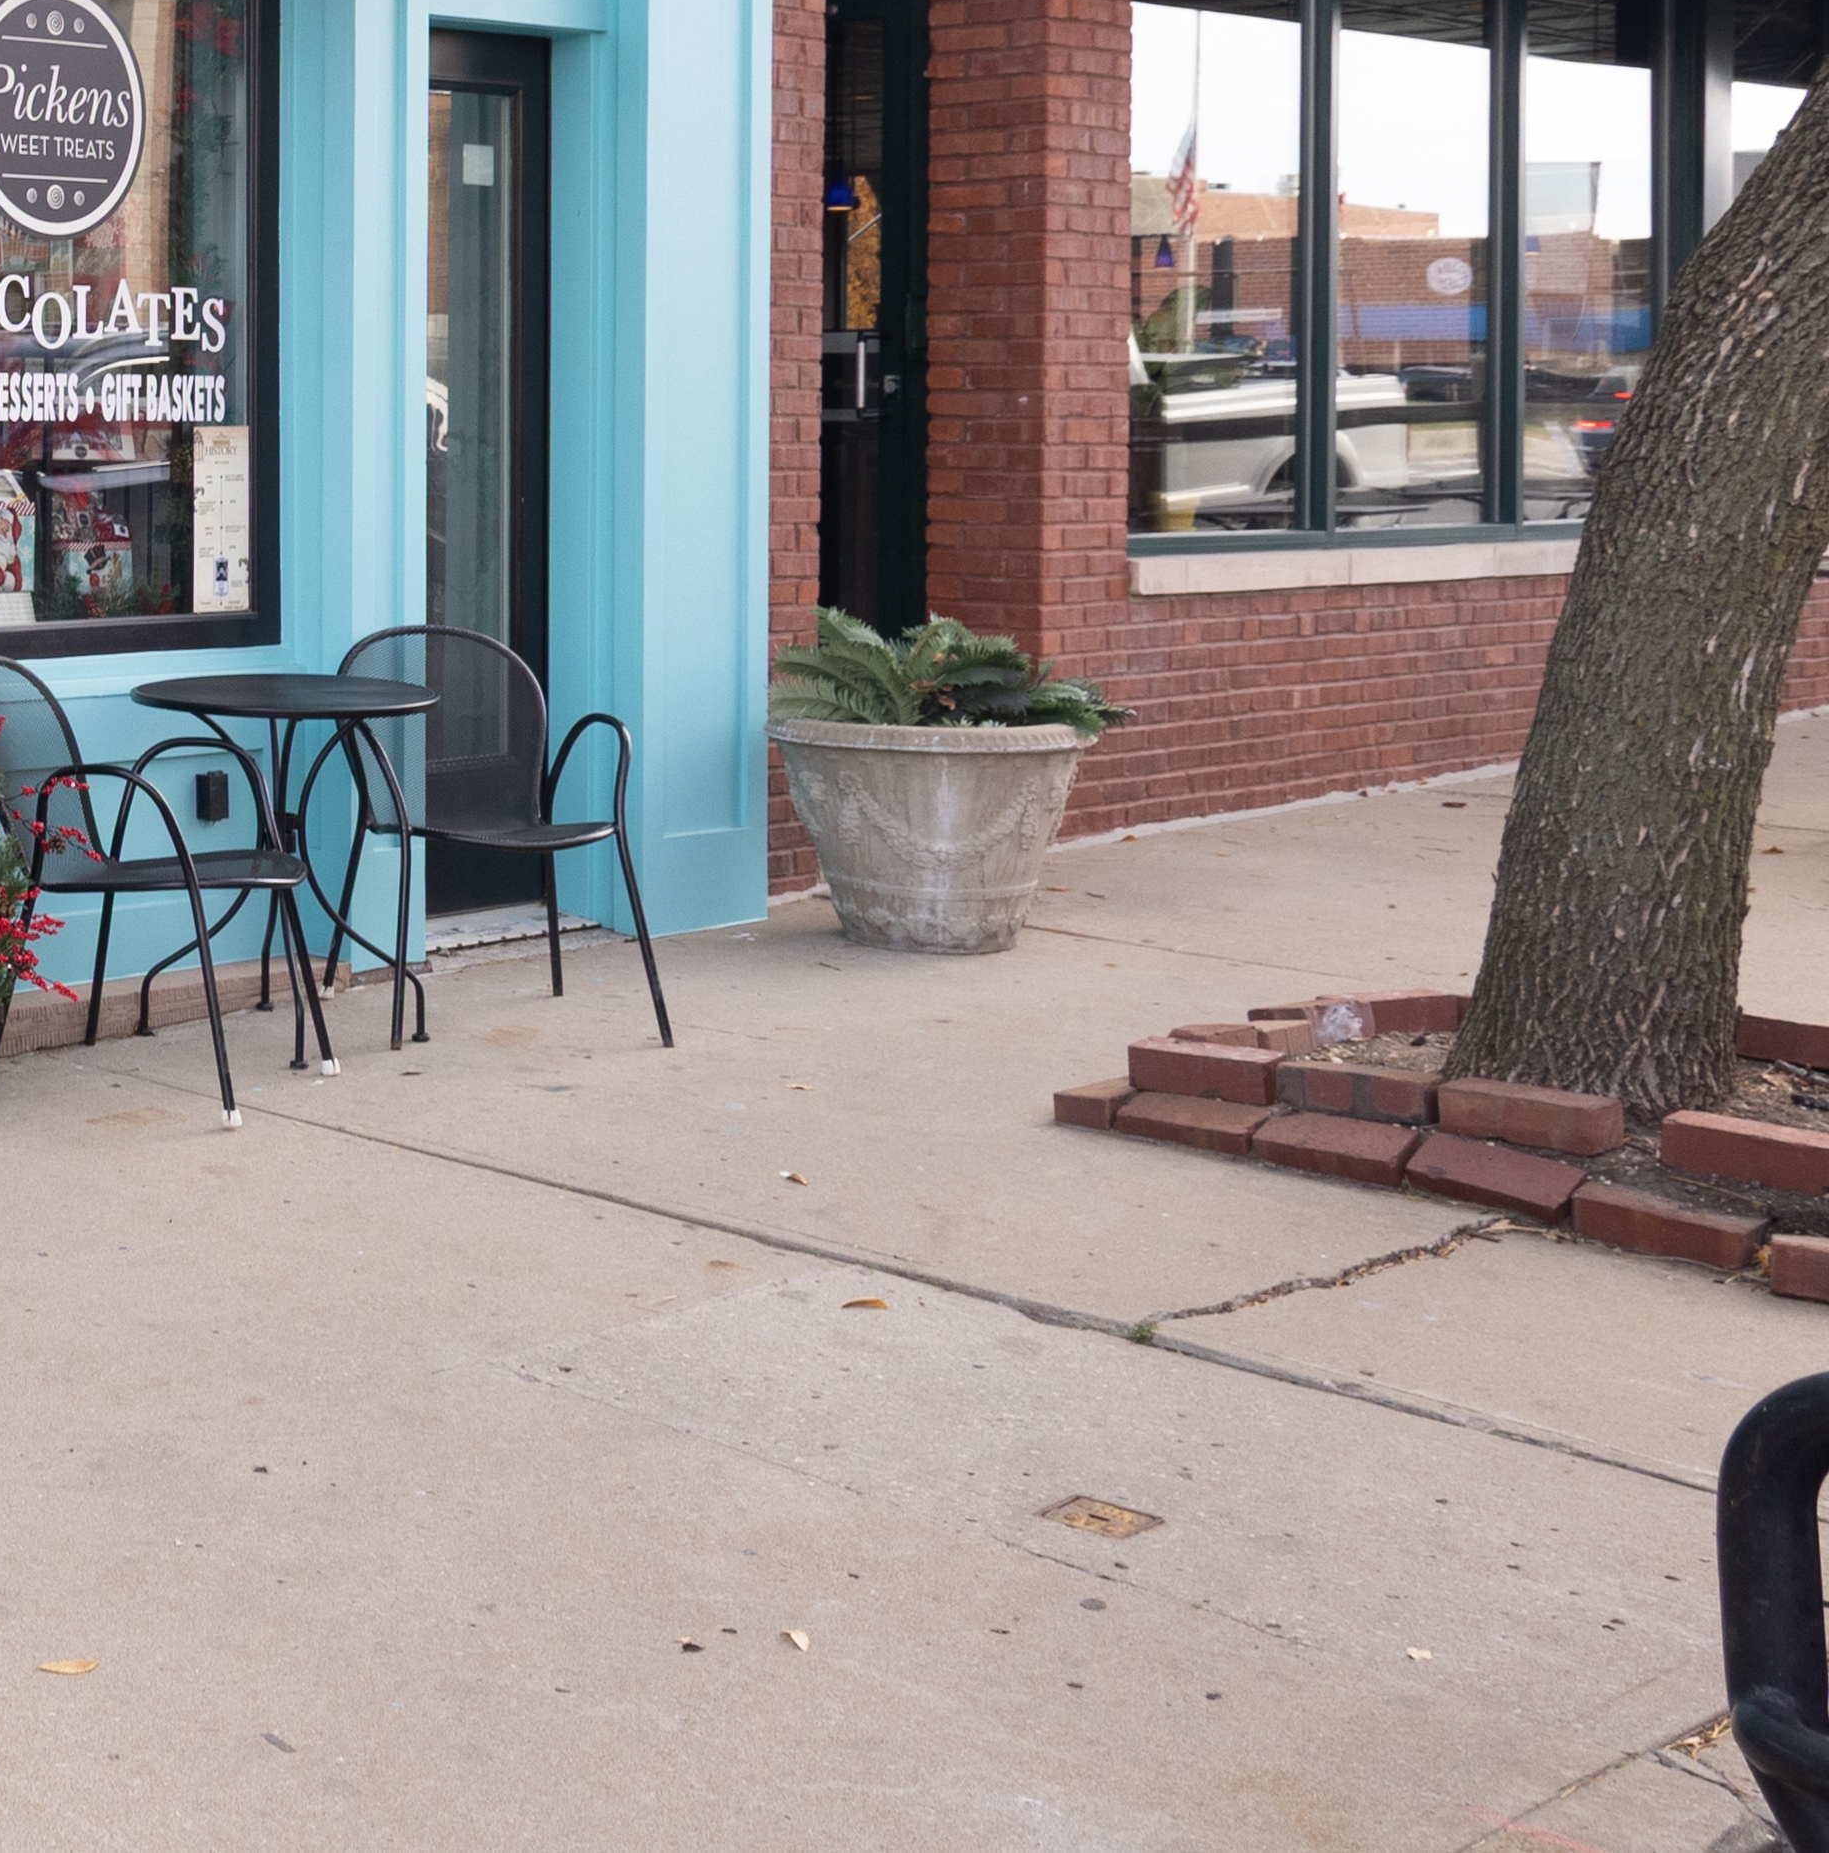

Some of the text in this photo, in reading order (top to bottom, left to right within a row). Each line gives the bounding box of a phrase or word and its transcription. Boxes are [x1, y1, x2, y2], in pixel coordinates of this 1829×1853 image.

[53, 135, 116, 162] TREATS
[101, 374, 144, 423] GIFT
[147, 374, 225, 424] BASKETS
[205, 446, 238, 456] HISTORY
